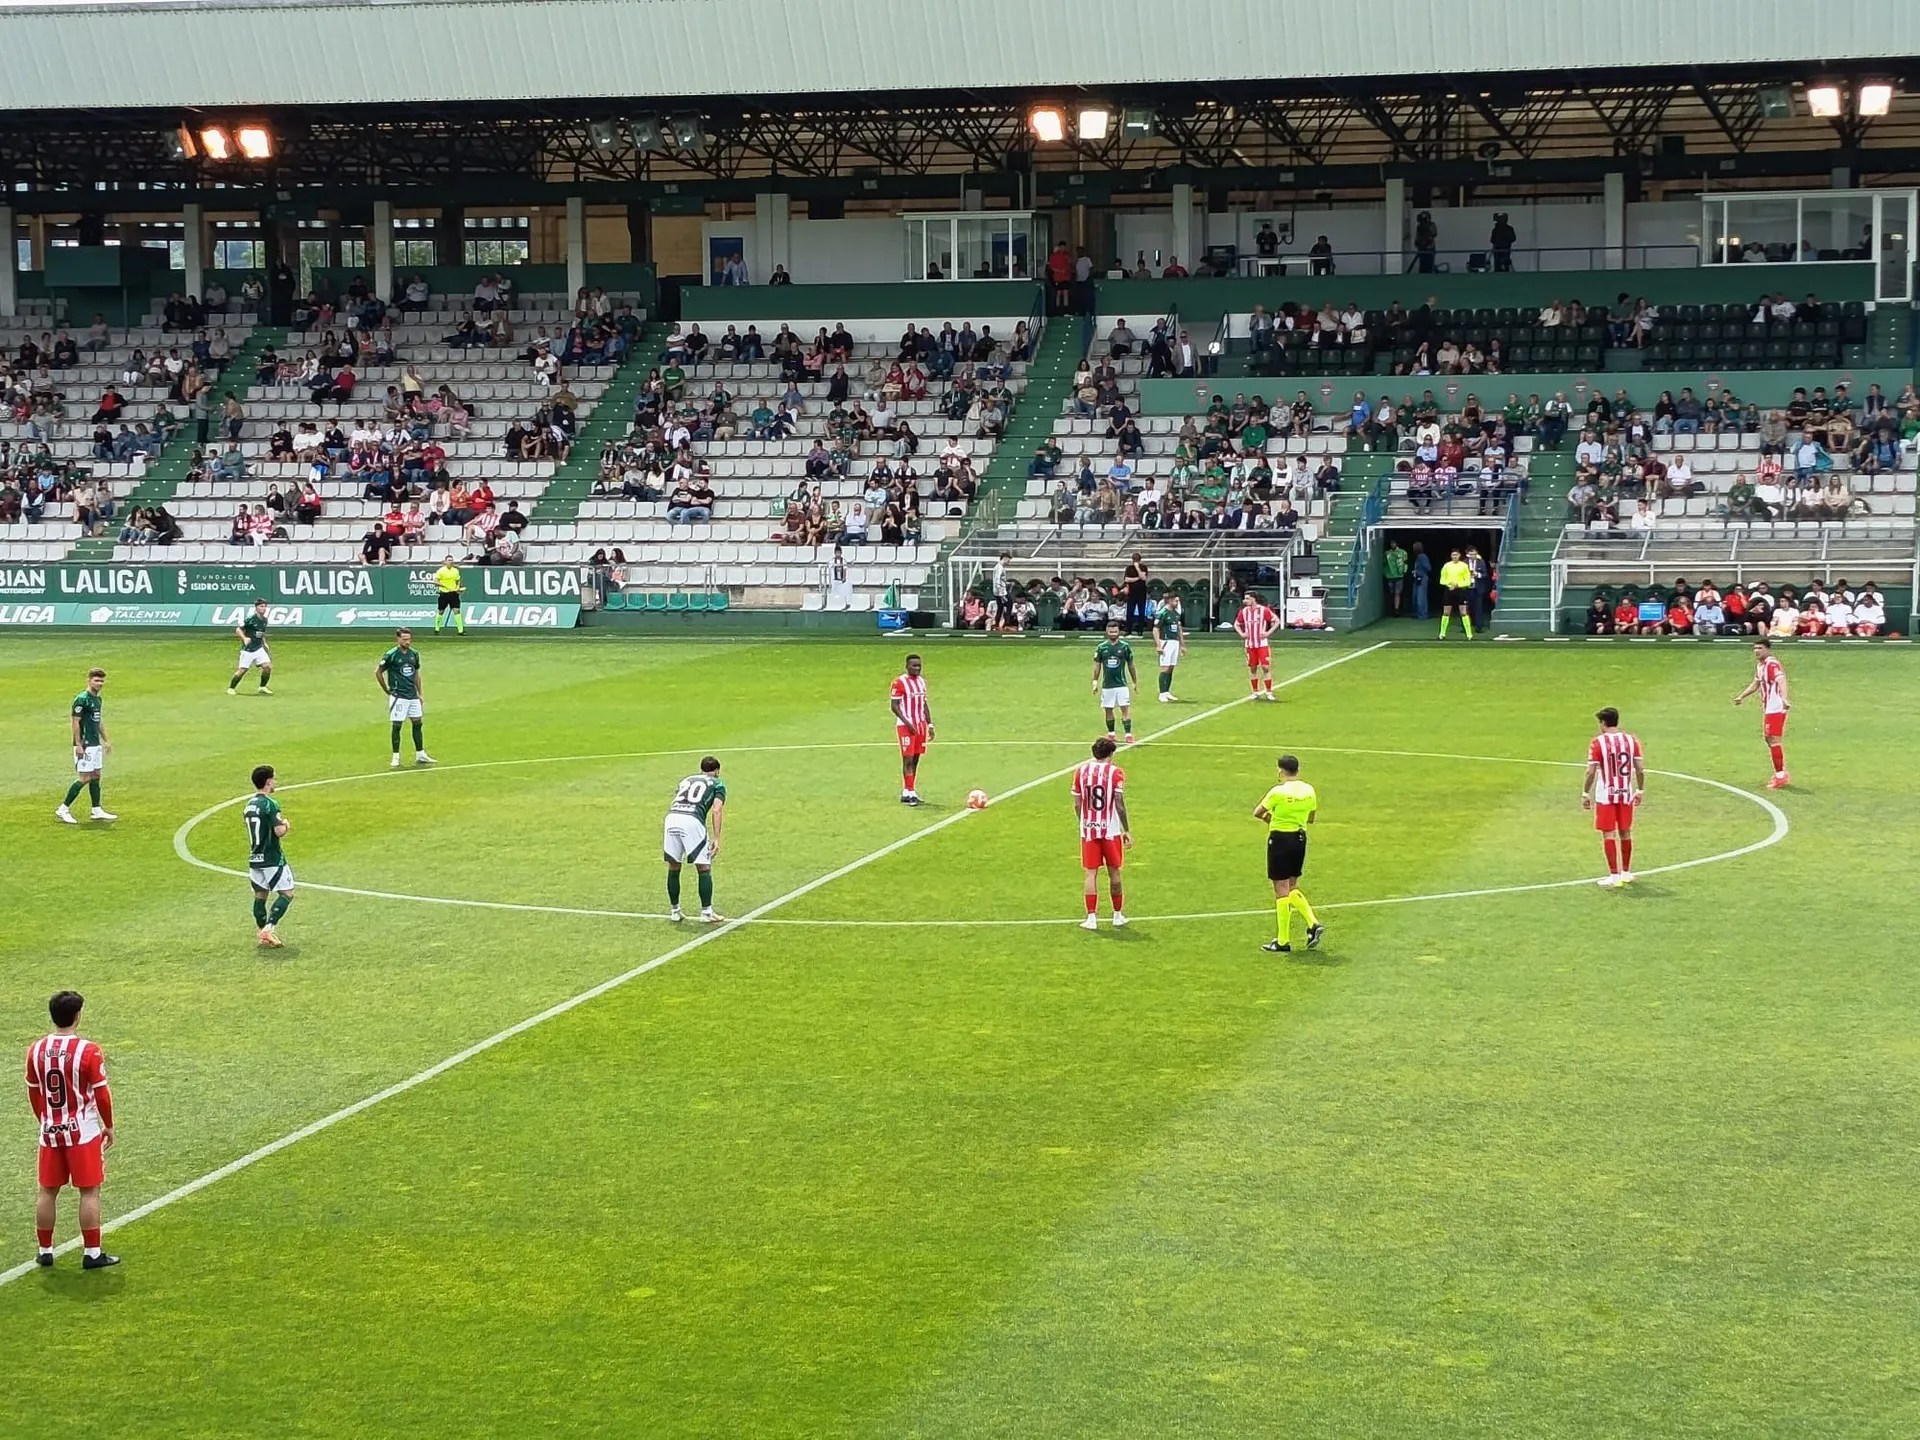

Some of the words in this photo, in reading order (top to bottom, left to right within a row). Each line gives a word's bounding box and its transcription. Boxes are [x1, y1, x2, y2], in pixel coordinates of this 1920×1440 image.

[60, 569, 153, 594] LALIGA
[191, 583, 219, 591] ISIDRO
[220, 583, 256, 591] SILVEIRA
[279, 570, 374, 595] LALIGA
[410, 571, 417, 580] A
[484, 569, 580, 596] LALIGA
[115, 611, 181, 619] TALENTUM
[464, 606, 558, 625] LALIGA
[1609, 751, 1630, 777] 12
[678, 780, 708, 803] 20
[1085, 784, 1106, 812] 18
[245, 816, 261, 846] 17
[46, 1067, 66, 1109] 9
